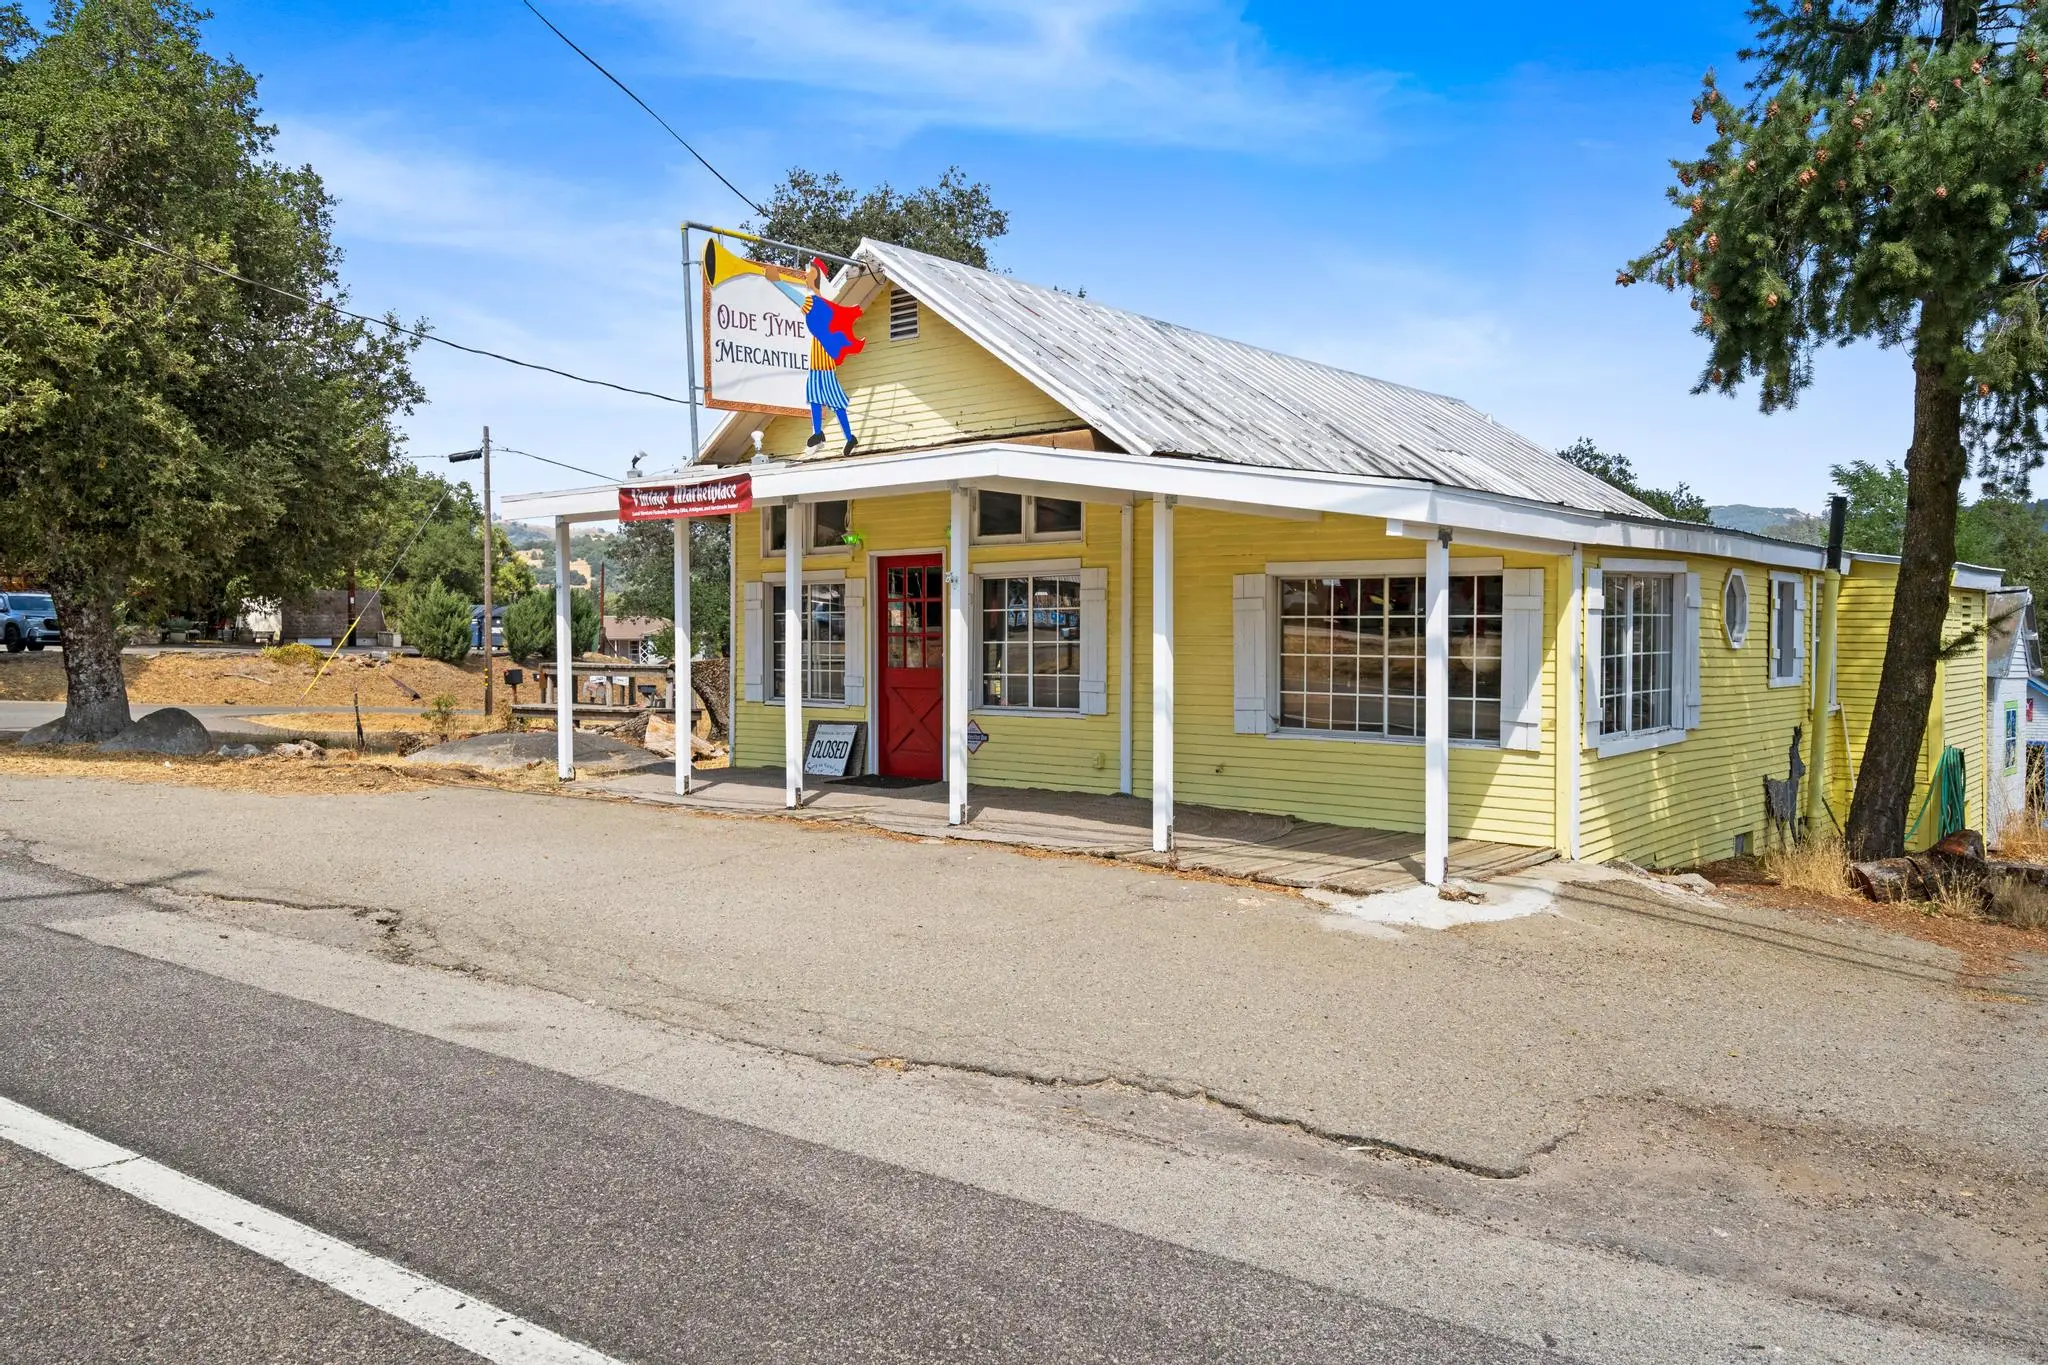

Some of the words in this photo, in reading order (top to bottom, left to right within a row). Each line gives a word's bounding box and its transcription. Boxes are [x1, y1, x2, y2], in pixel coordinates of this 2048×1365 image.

[717, 304, 757, 331] OLDE
[763, 312, 805, 338] TYME
[715, 339, 809, 370] MERCANTILE
[631, 488, 669, 509] Vintage
[673, 481, 737, 504] Marketplace
[811, 740, 849, 759] CLOSED
